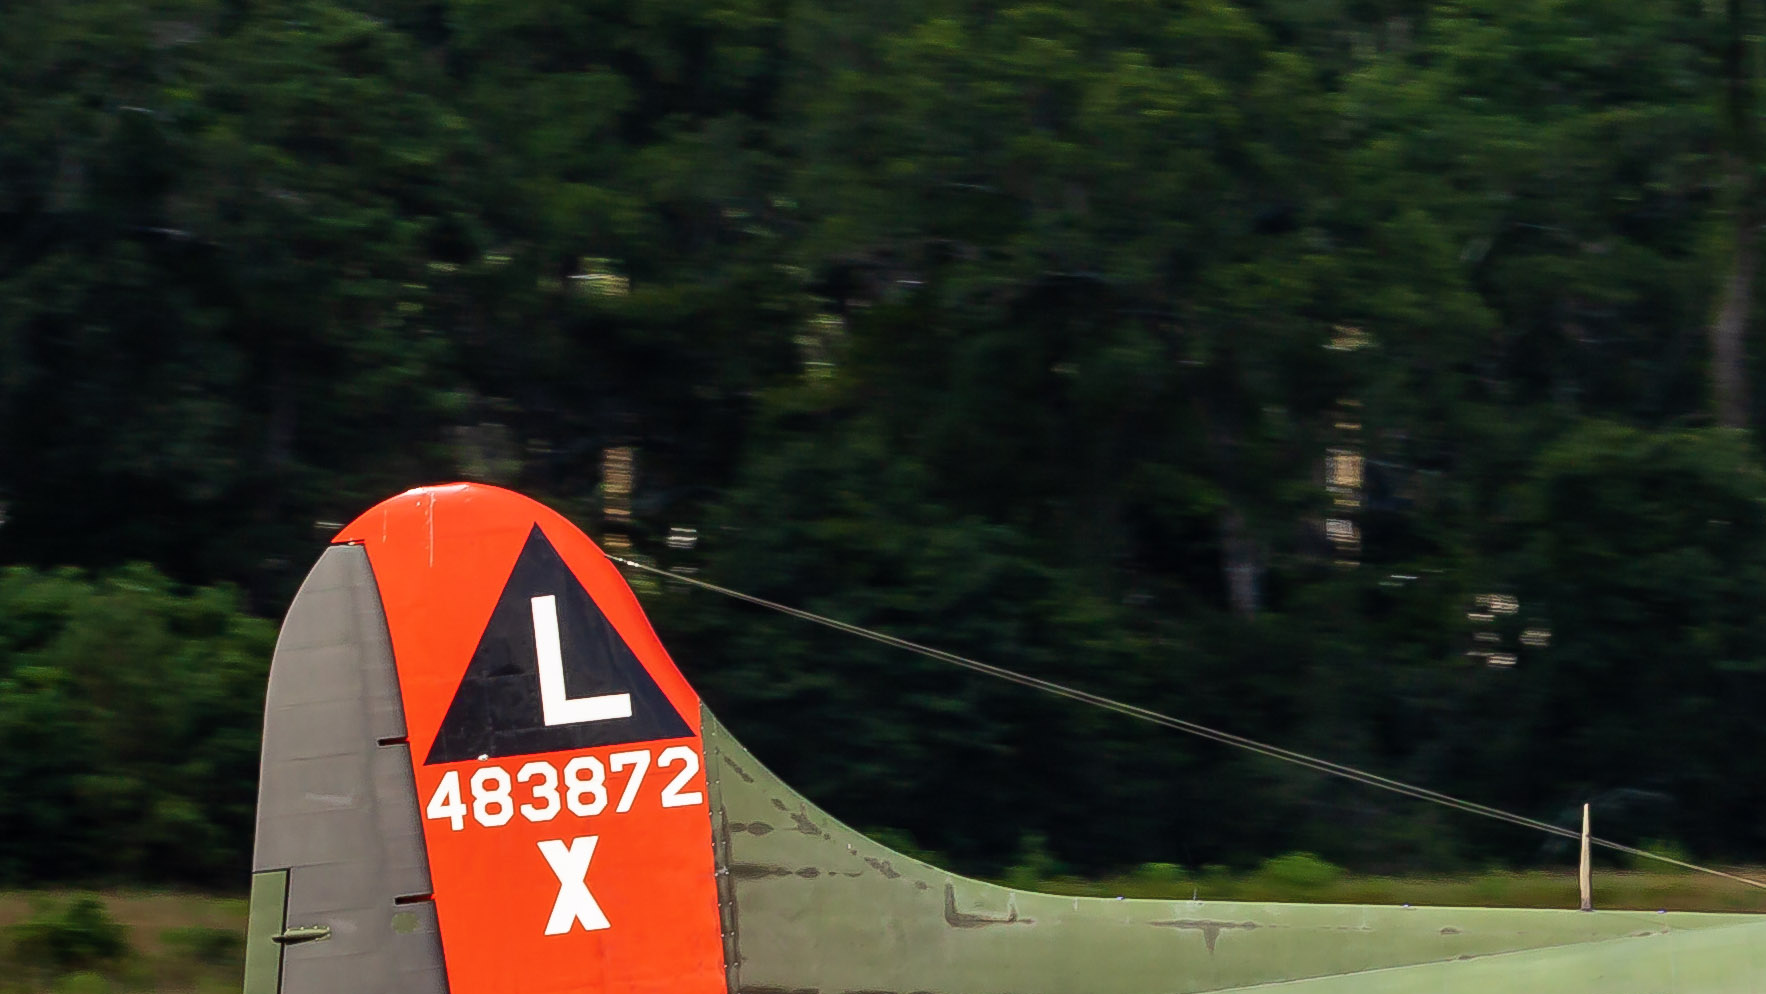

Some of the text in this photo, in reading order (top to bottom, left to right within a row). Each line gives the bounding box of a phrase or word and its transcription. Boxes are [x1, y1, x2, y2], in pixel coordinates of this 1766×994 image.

[531, 595, 632, 726] L
[427, 747, 703, 831] 483872
[537, 836, 610, 936] X
